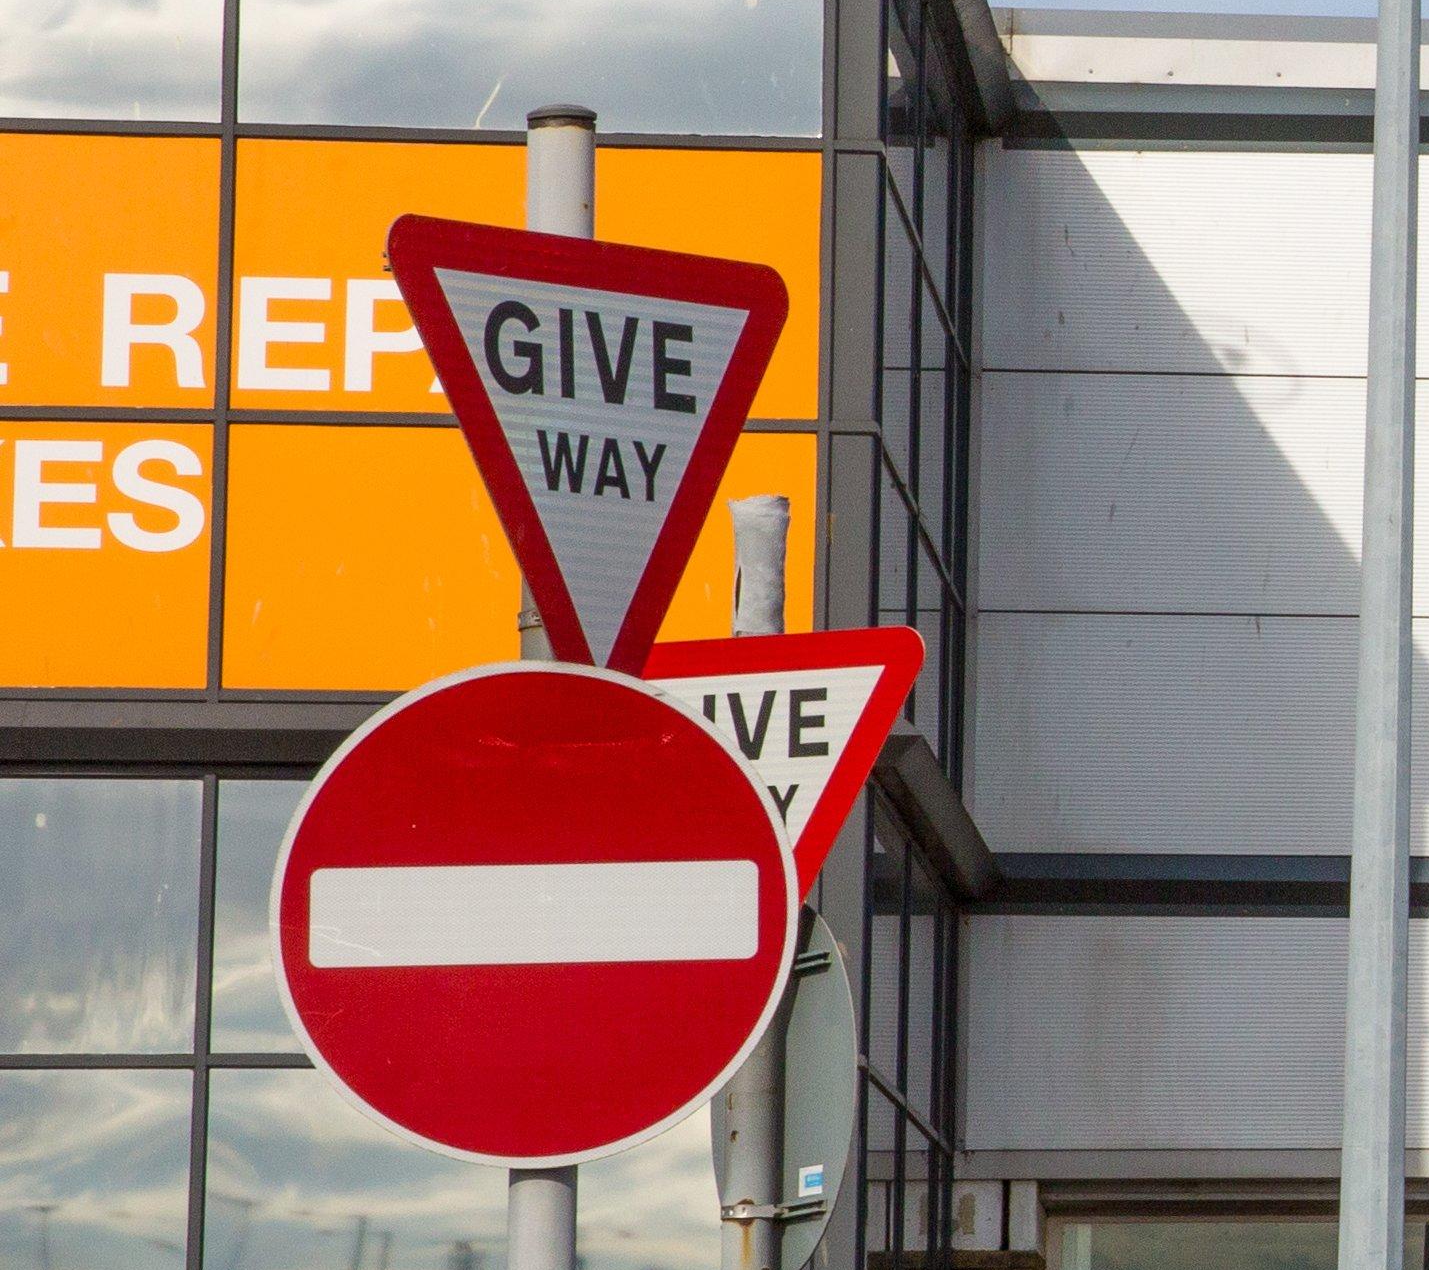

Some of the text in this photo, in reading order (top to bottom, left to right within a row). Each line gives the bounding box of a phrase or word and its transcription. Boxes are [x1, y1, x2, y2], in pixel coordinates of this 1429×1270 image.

[101, 273, 448, 393] REP
[484, 300, 697, 414] GIVE
[0, 438, 206, 553] ES
[536, 429, 668, 502] WAY
[702, 687, 829, 761] VE
